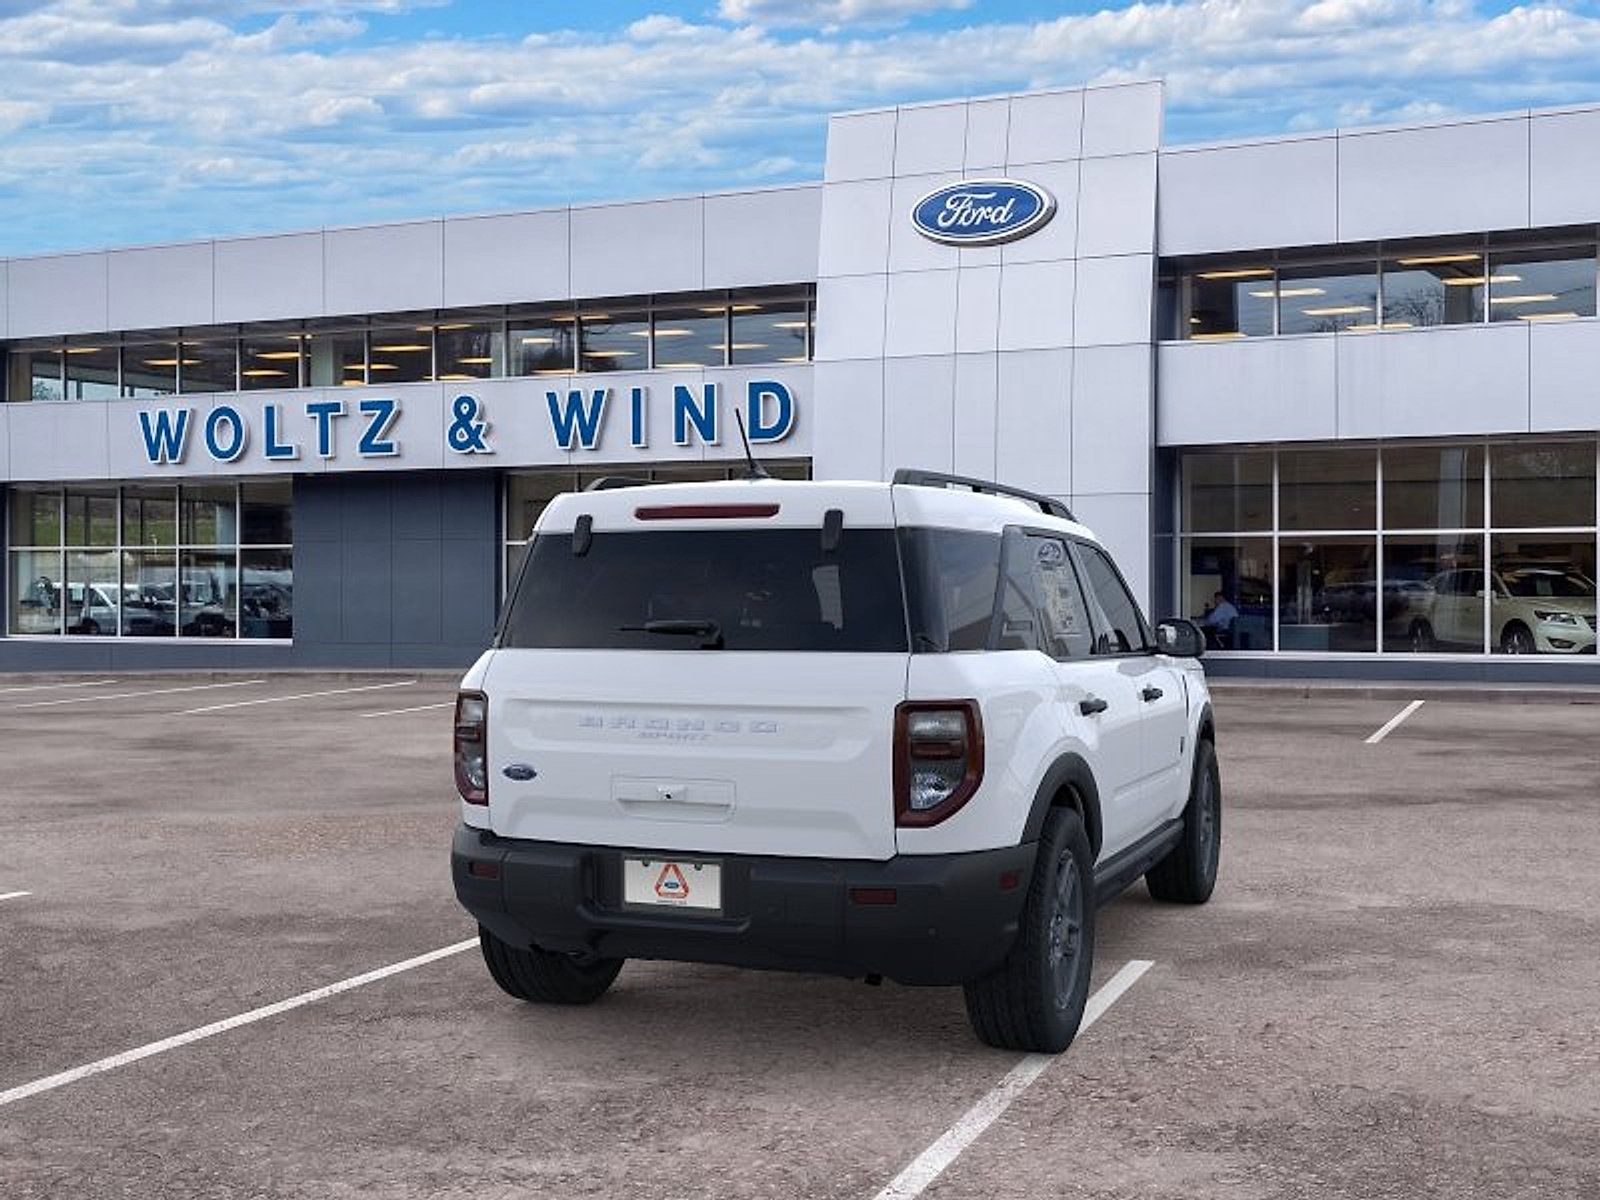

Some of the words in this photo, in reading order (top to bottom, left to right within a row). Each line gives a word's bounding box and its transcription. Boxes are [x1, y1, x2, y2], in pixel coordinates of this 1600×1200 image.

[938, 191, 1016, 228] Ford
[138, 398, 401, 464] WOLTZ
[447, 393, 497, 454] &
[545, 378, 796, 450] WIND
